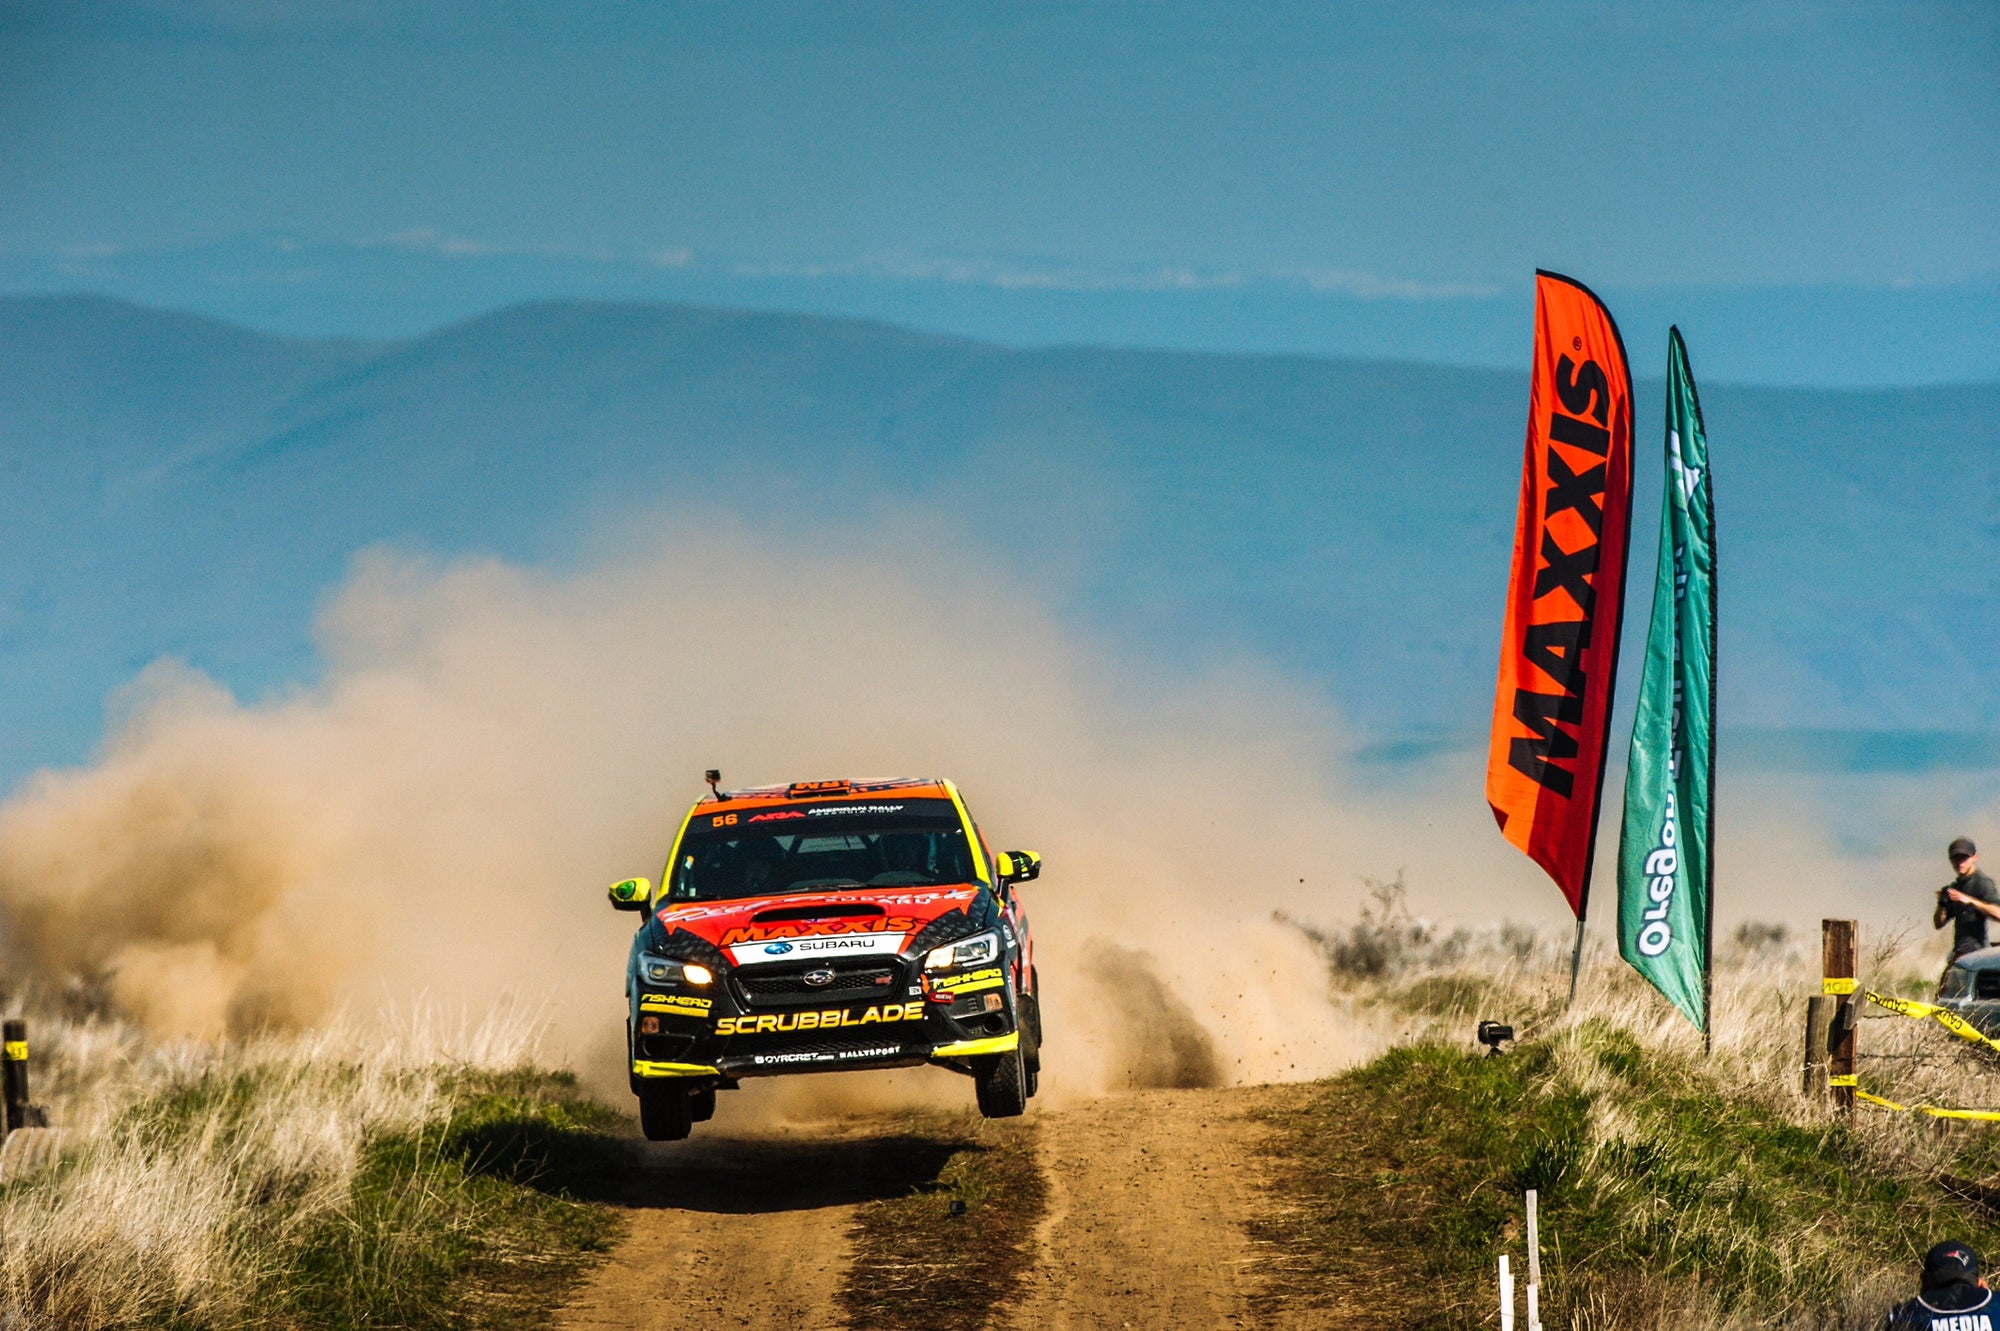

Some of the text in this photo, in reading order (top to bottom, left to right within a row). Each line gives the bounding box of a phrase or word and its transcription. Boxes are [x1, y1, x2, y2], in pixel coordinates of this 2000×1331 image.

[712, 813, 738, 828] 56
[719, 917, 915, 946] MAXXIS
[800, 940, 875, 951] SUBARU
[715, 1001, 926, 1035] SCRUBBLADE
[839, 1045, 901, 1059] RALLYSPORT
[1931, 1315, 1993, 1331] MEDIA
